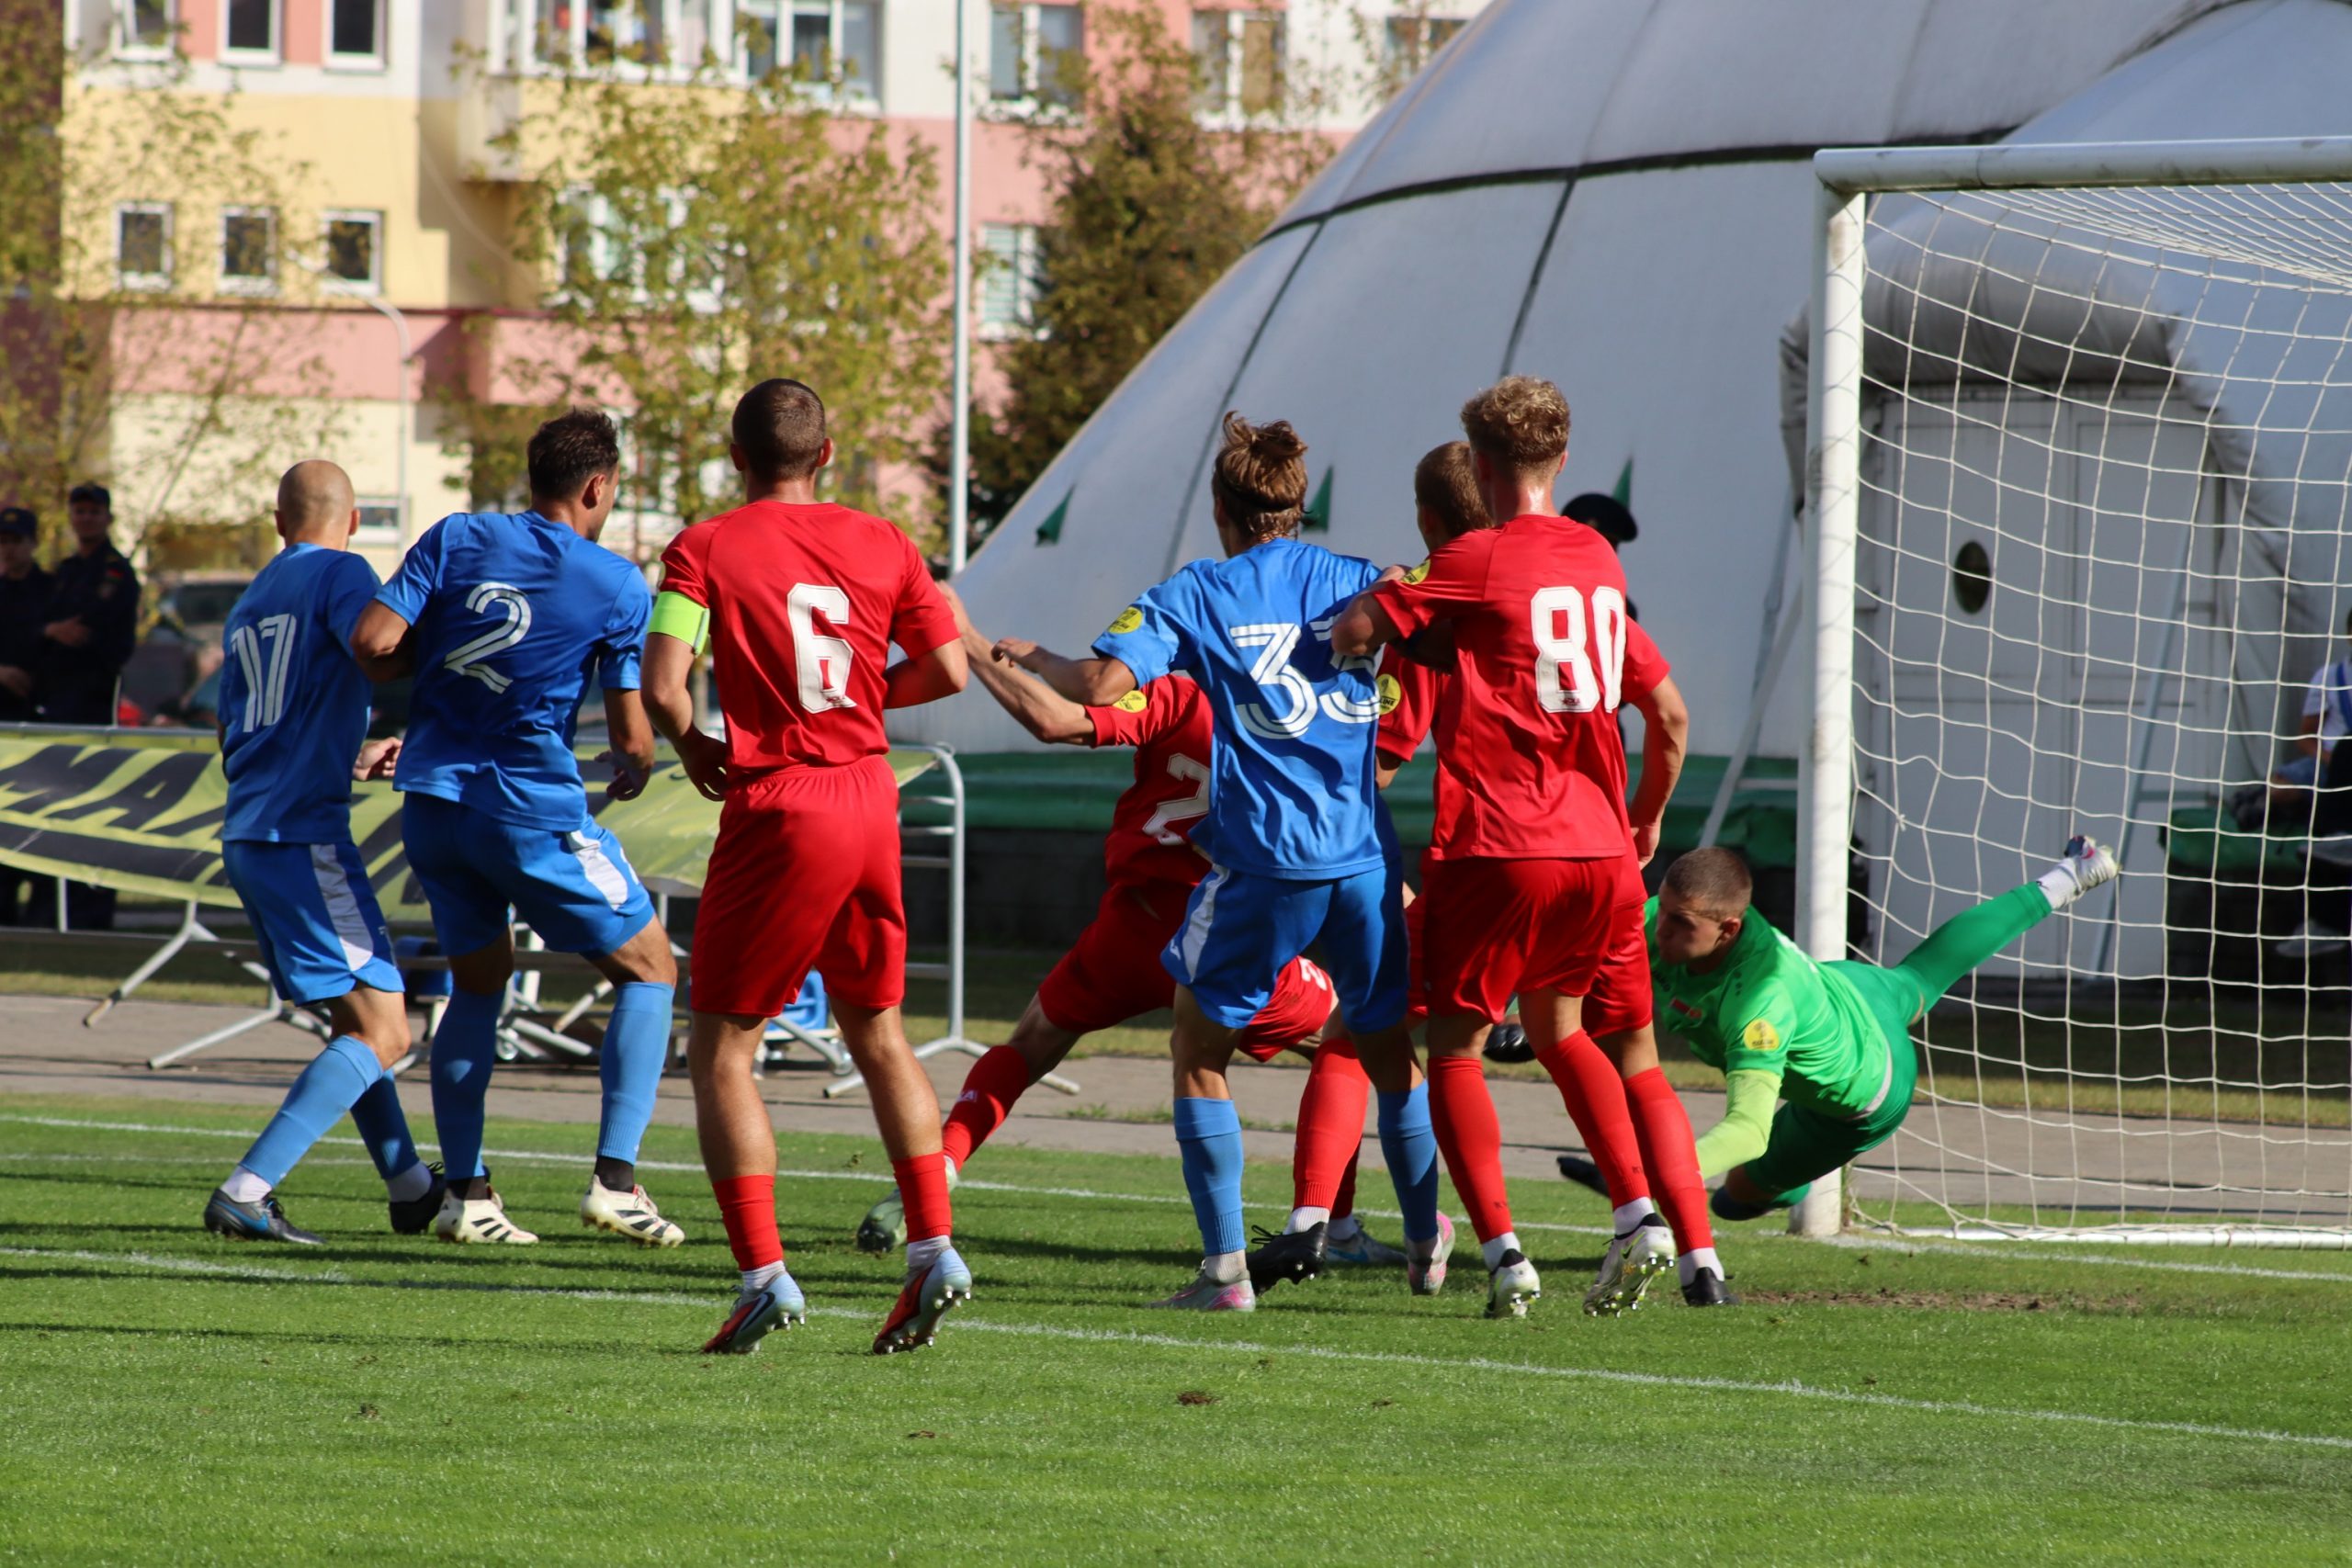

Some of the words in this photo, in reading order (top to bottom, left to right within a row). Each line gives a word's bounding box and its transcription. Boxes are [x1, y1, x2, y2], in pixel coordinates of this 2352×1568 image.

[230, 614, 297, 732] 17
[445, 581, 532, 694] 2
[786, 582, 856, 714] 6
[1531, 585, 1625, 713] 80
